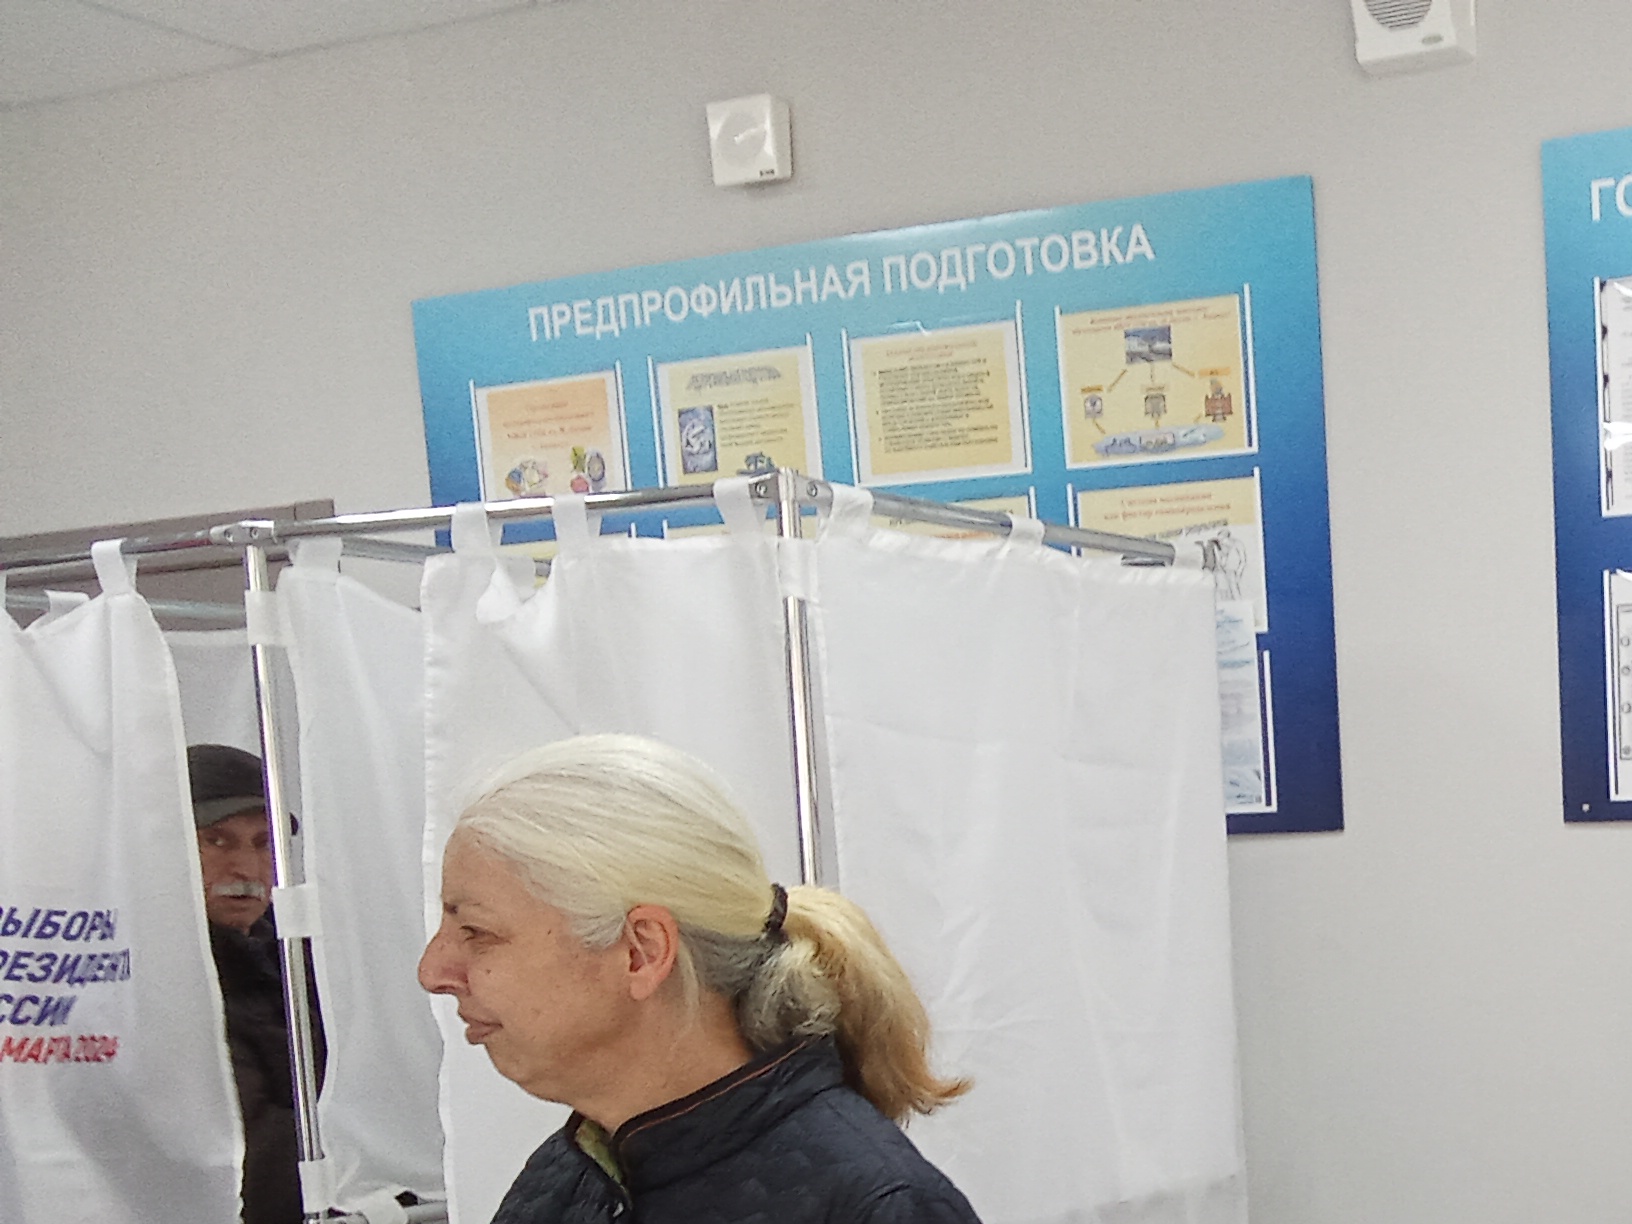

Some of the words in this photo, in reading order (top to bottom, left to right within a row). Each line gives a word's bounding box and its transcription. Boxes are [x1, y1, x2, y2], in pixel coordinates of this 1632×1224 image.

[527, 259, 871, 342] ПРЕДПРОФИЛЬНАЯ
[883, 223, 1156, 294] ПОДГОТОВКА
[0, 906, 118, 942] ЫБОРЫ
